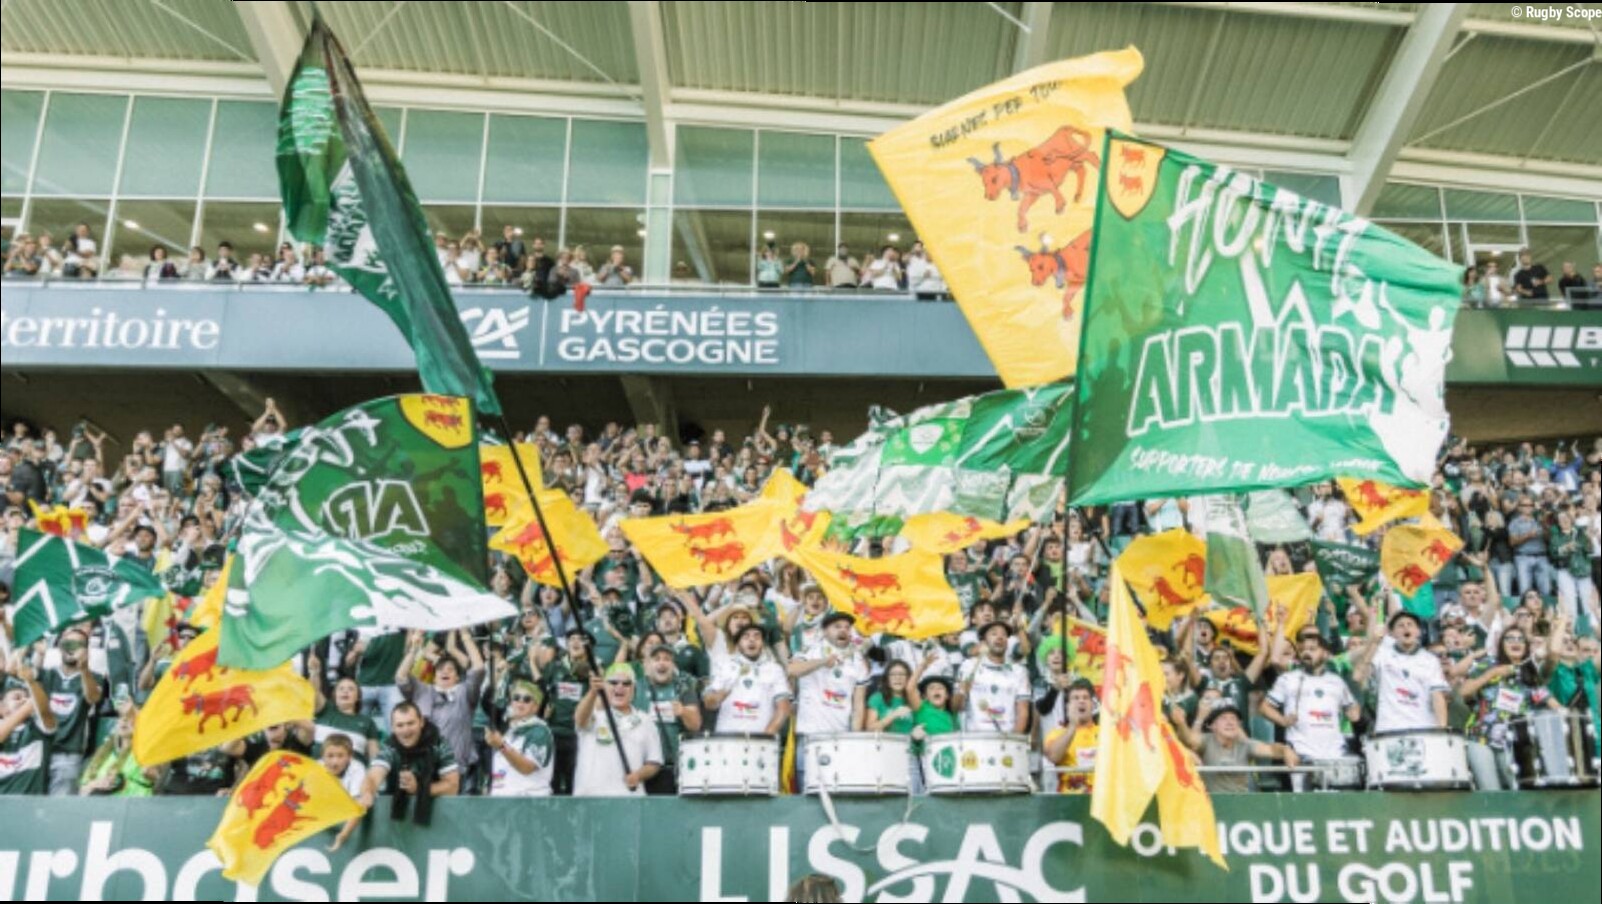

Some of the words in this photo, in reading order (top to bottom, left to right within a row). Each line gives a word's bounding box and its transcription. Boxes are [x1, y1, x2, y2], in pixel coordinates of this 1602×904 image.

[560, 305, 779, 336] PYRÉNÉES
[558, 337, 779, 364] GASCOGNE
[1126, 322, 1397, 438] ARMADA
[1131, 820, 1317, 857] OIQUE
[1326, 819, 1374, 854] ET
[1385, 816, 1583, 853] AUDITION
[700, 821, 1086, 902] LISSAC
[1249, 861, 1321, 902] DU
[1337, 861, 1473, 902] GOLF
